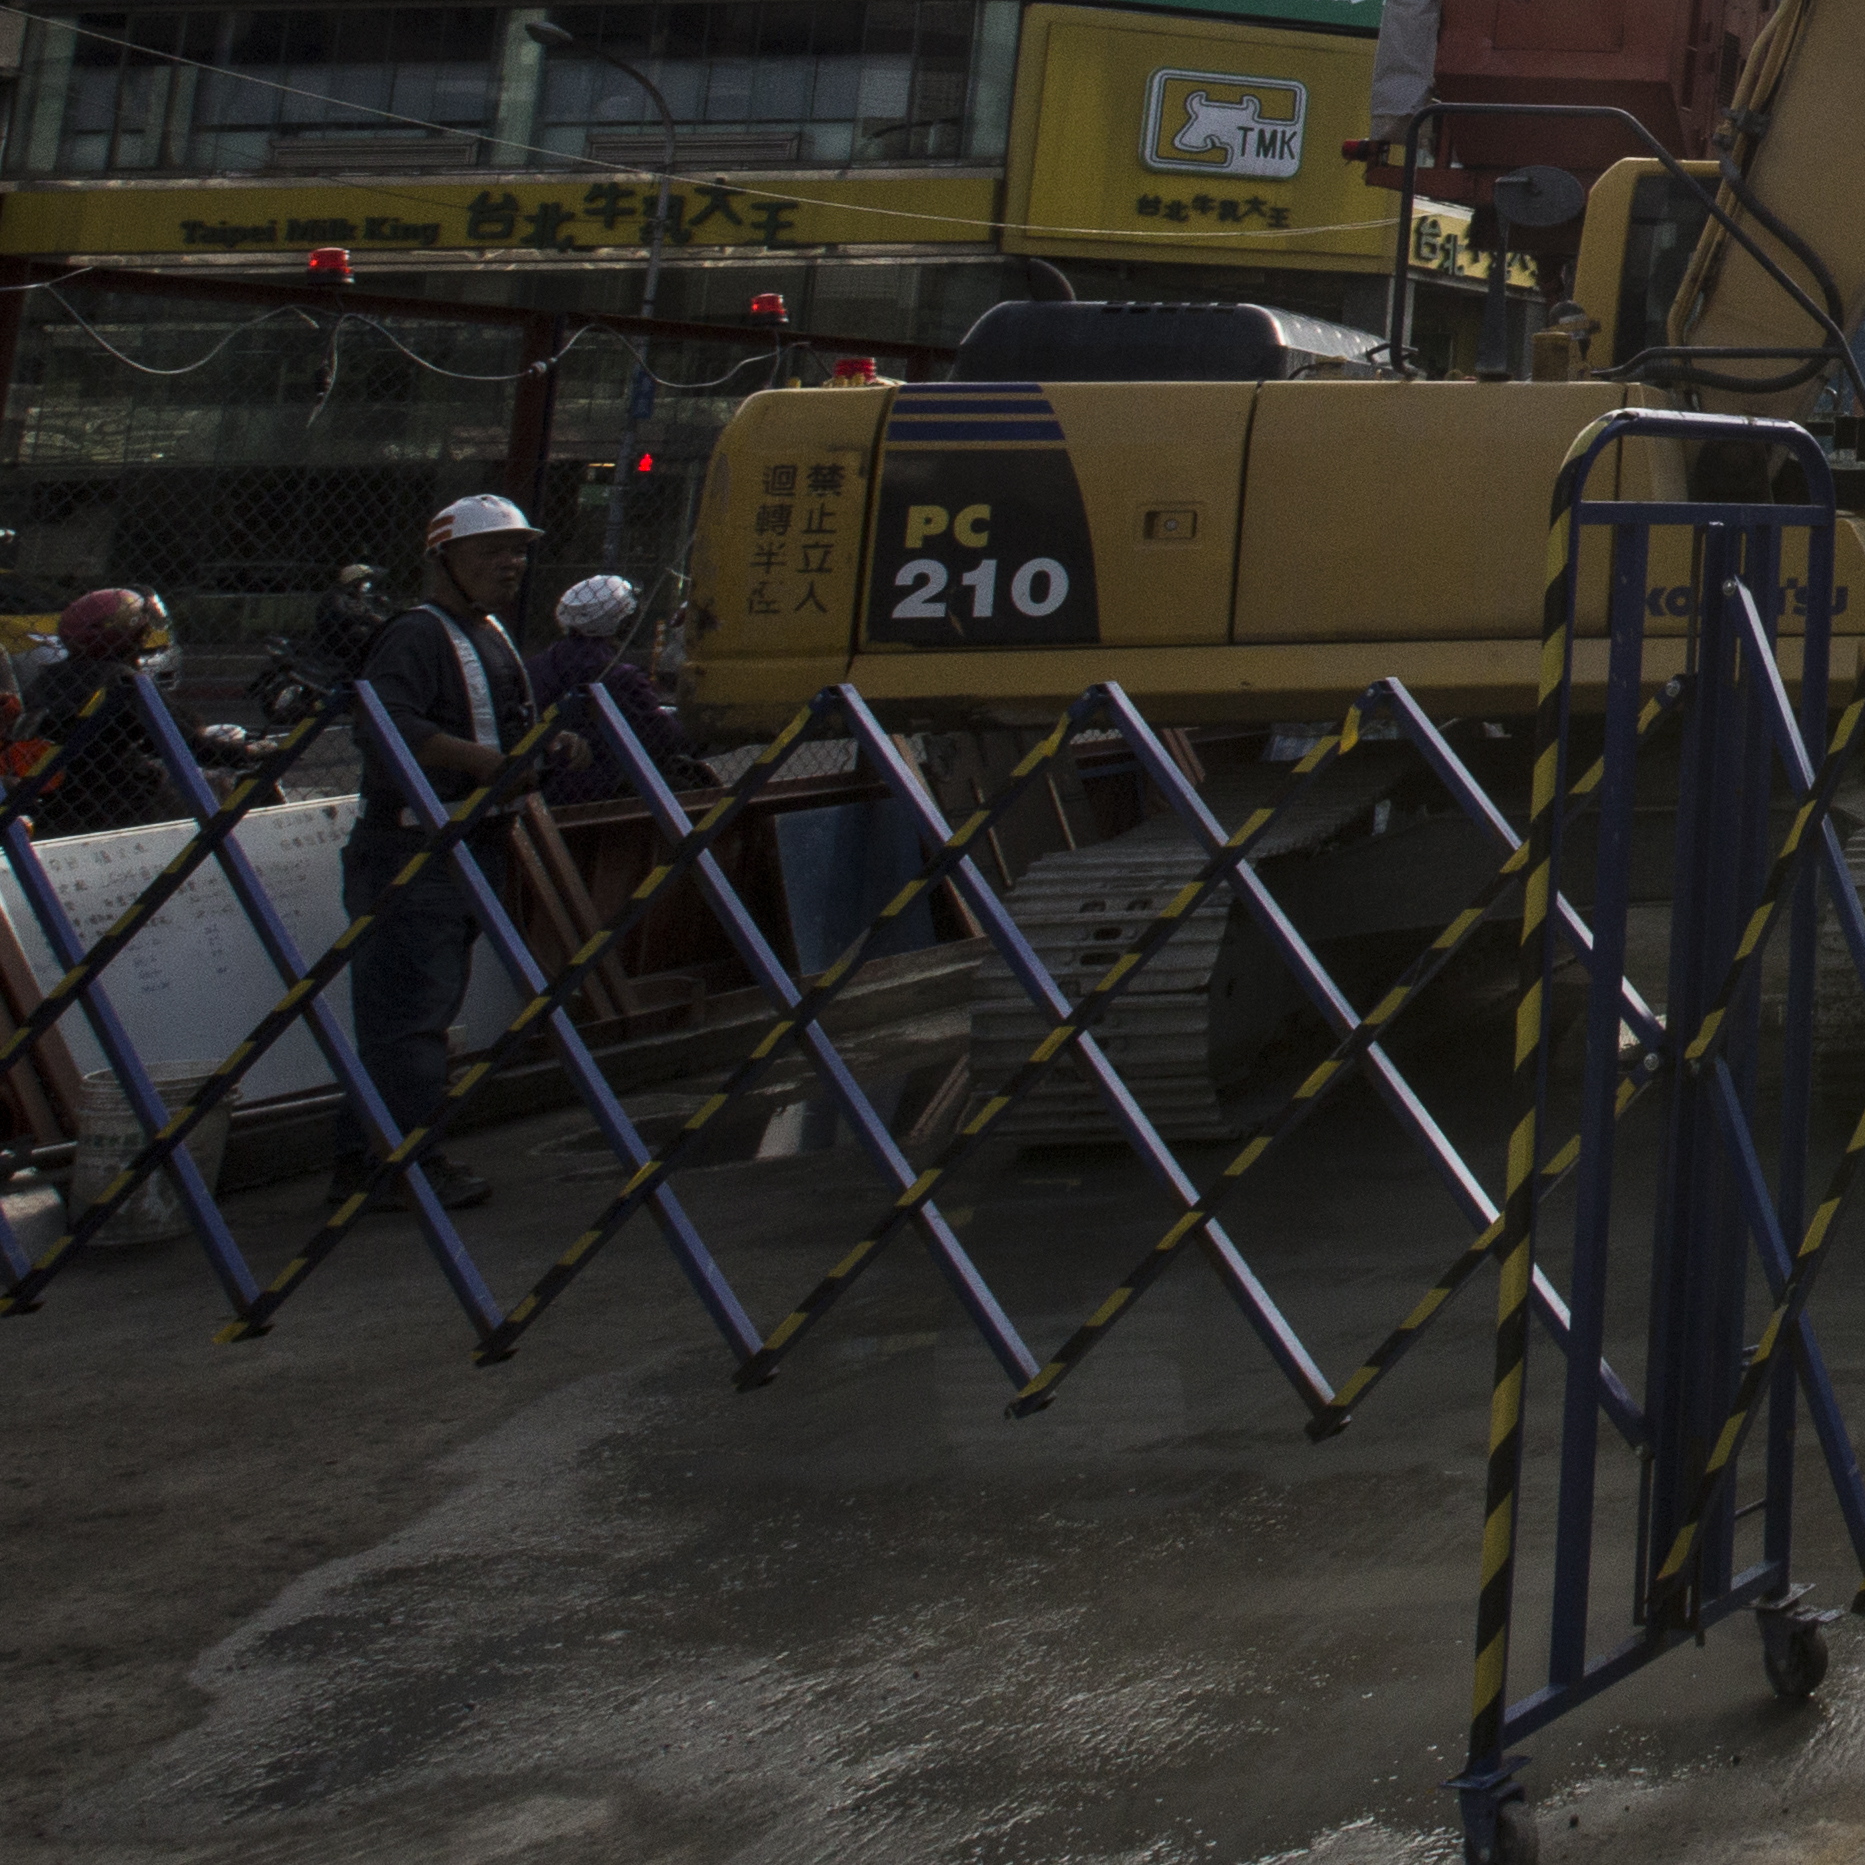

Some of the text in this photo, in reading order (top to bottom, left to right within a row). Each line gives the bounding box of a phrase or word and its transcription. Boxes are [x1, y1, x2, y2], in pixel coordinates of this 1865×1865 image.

[1237, 126, 1298, 160] TMK
[180, 218, 440, 246] Taipei Milk King
[467, 180, 798, 252] 台北牛乳大王
[1137, 194, 1291, 229] 台北牛乳大王
[792, 462, 846, 615] 禁止立人
[904, 503, 991, 548] PC
[891, 558, 1070, 618] 210
